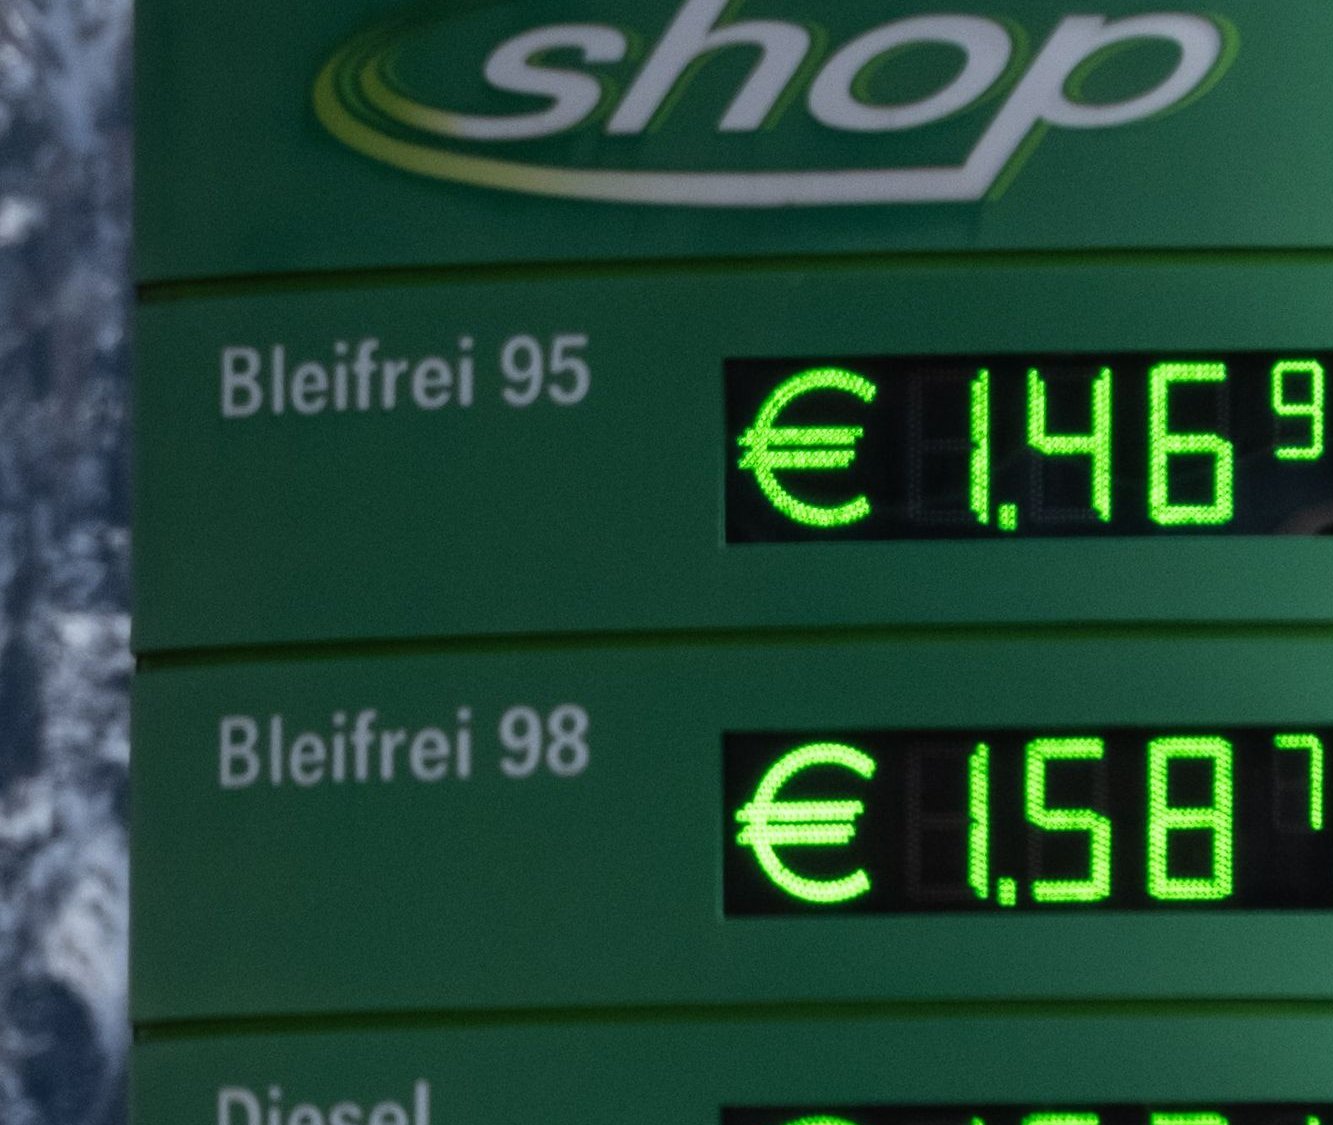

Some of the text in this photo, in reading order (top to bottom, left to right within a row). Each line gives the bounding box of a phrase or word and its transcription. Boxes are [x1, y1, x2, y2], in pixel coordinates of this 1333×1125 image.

[480, 0, 1222, 202] shop
[219, 333, 592, 417] Bleifrei 95
[735, 365, 878, 528] €
[218, 703, 591, 788] Bleifrei 98
[734, 740, 878, 904] €
